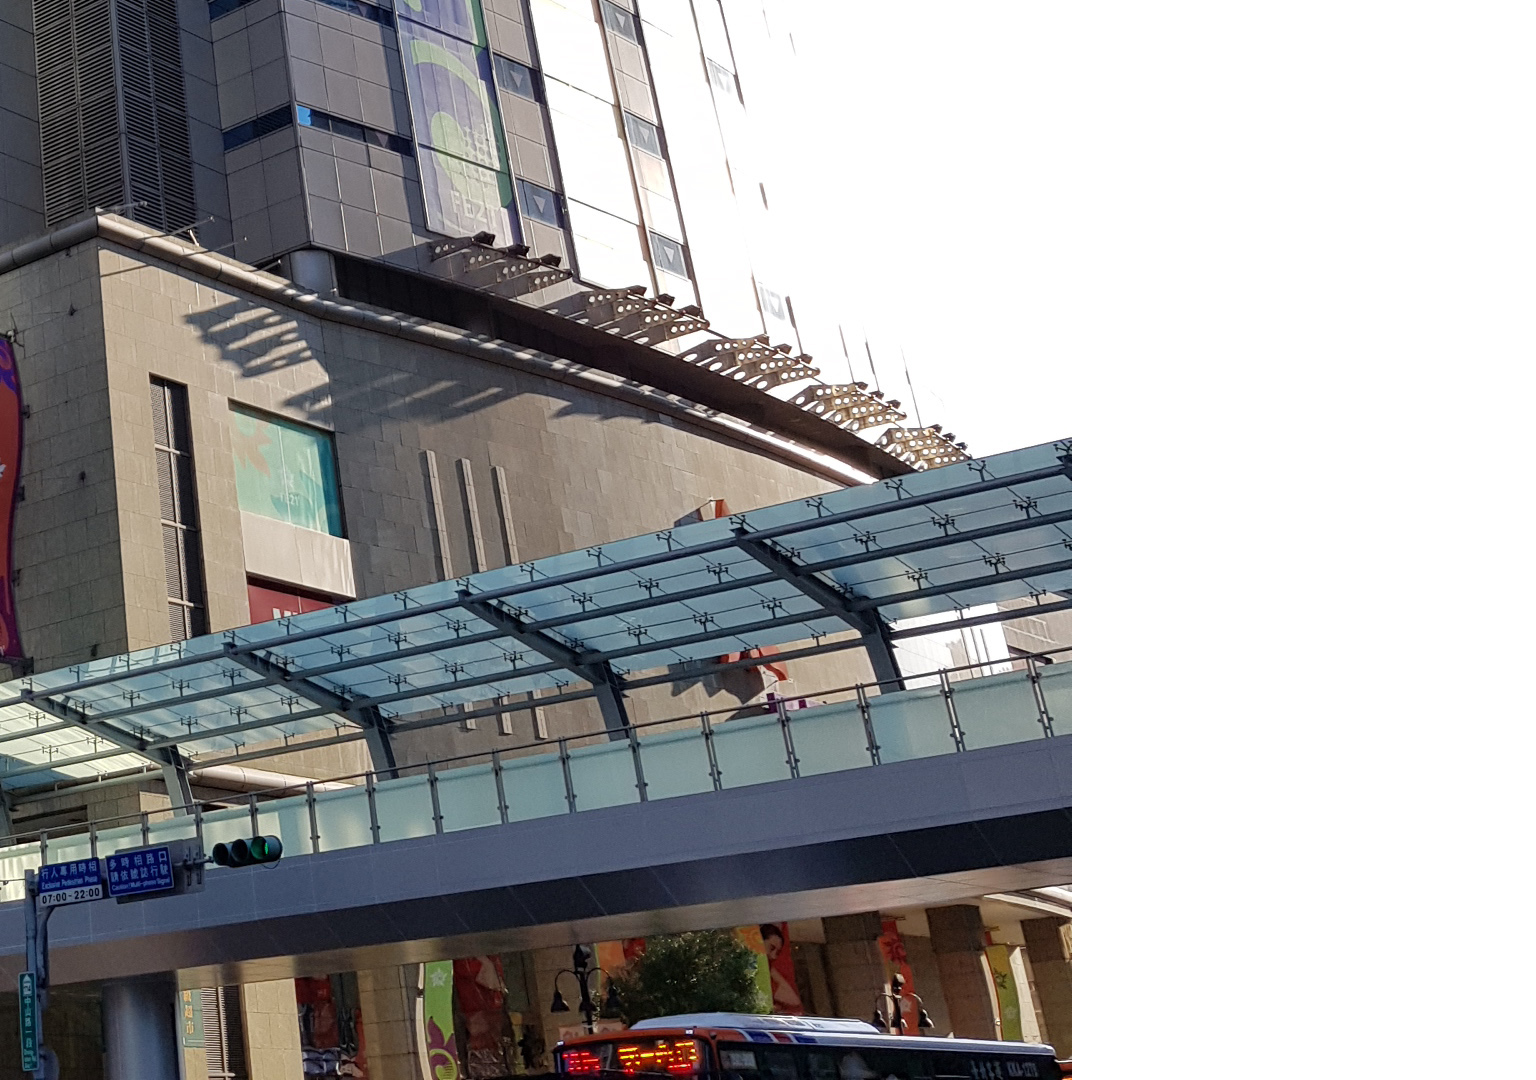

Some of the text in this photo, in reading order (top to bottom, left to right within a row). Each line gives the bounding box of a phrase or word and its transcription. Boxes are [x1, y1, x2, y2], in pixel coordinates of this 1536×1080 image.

[109, 851, 167, 870] 多時相路口
[41, 861, 97, 880] 行人專用時相
